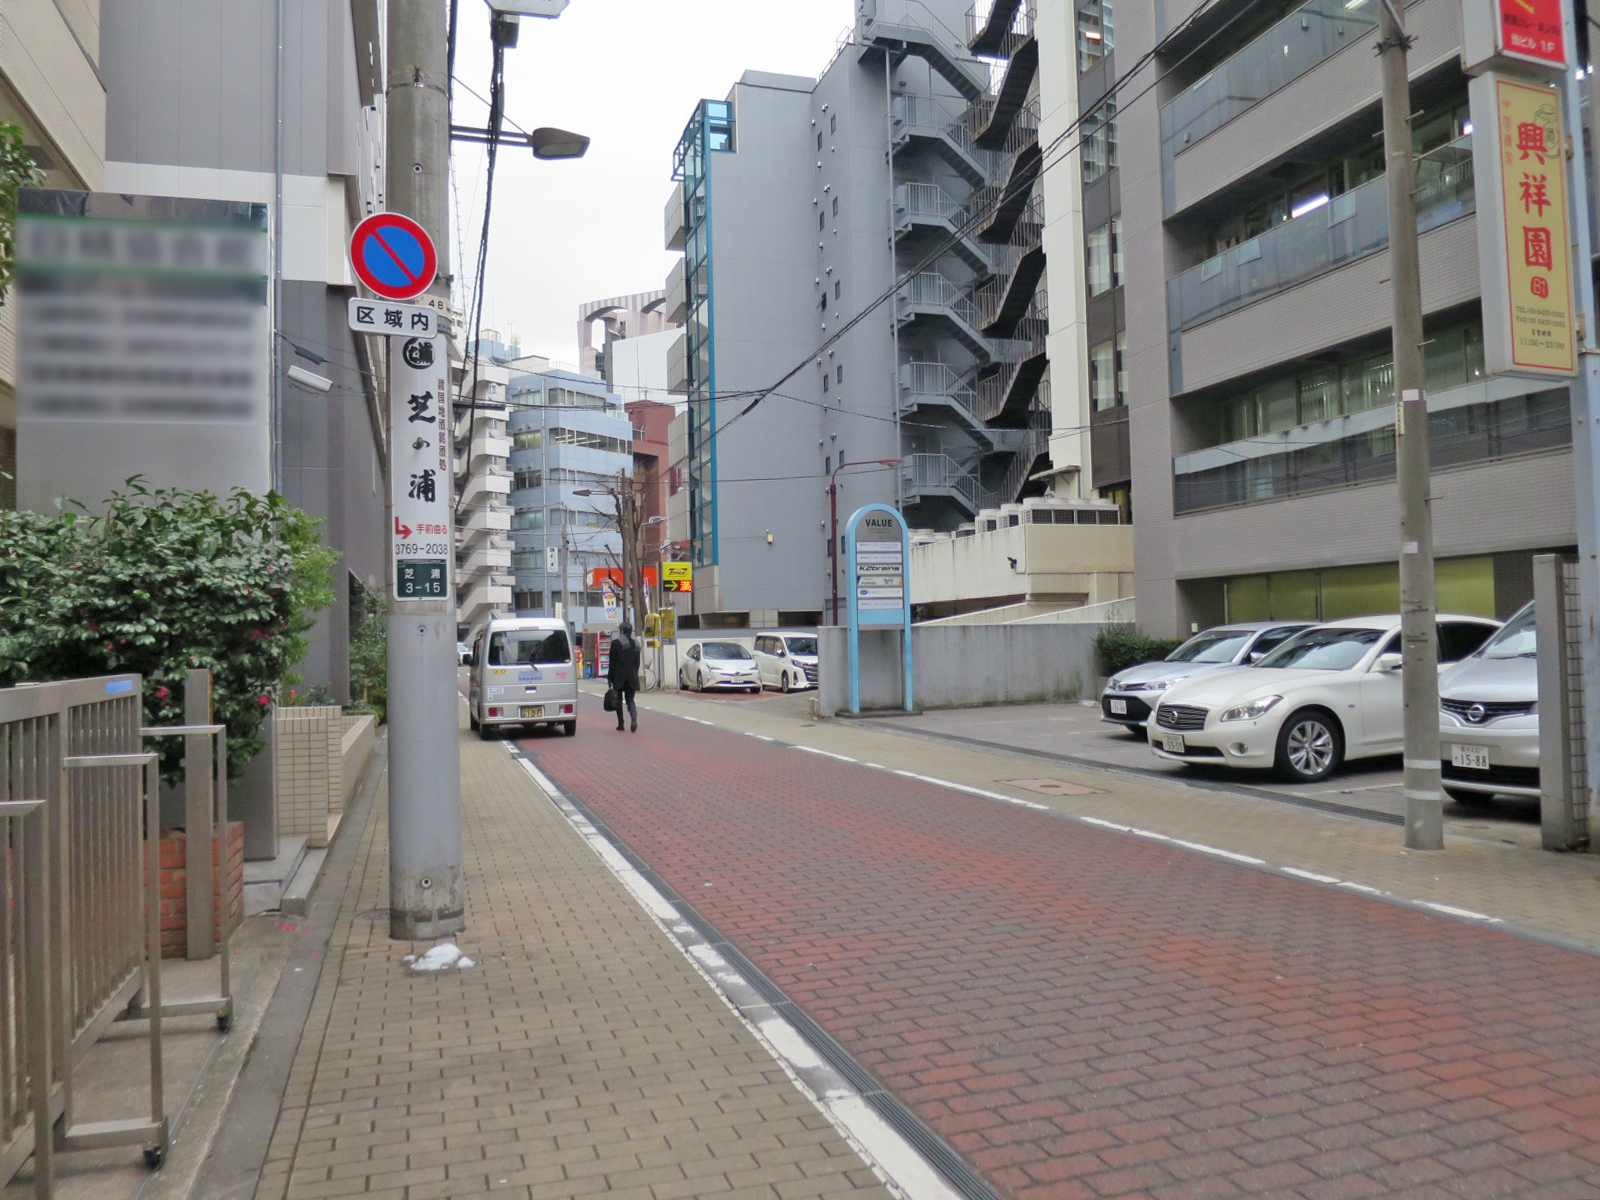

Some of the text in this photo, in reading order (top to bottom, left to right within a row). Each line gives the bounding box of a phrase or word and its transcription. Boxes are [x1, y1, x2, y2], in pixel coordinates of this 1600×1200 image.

[1516, 122, 1553, 272] 興祥園
[357, 306, 429, 331] 区域内
[416, 523, 447, 535] 手前曲る
[865, 519, 893, 527] VALUE
[395, 543, 447, 555] 3769-2038
[405, 582, 441, 594] 3-15
[1461, 754, 1487, 767] 15-88
